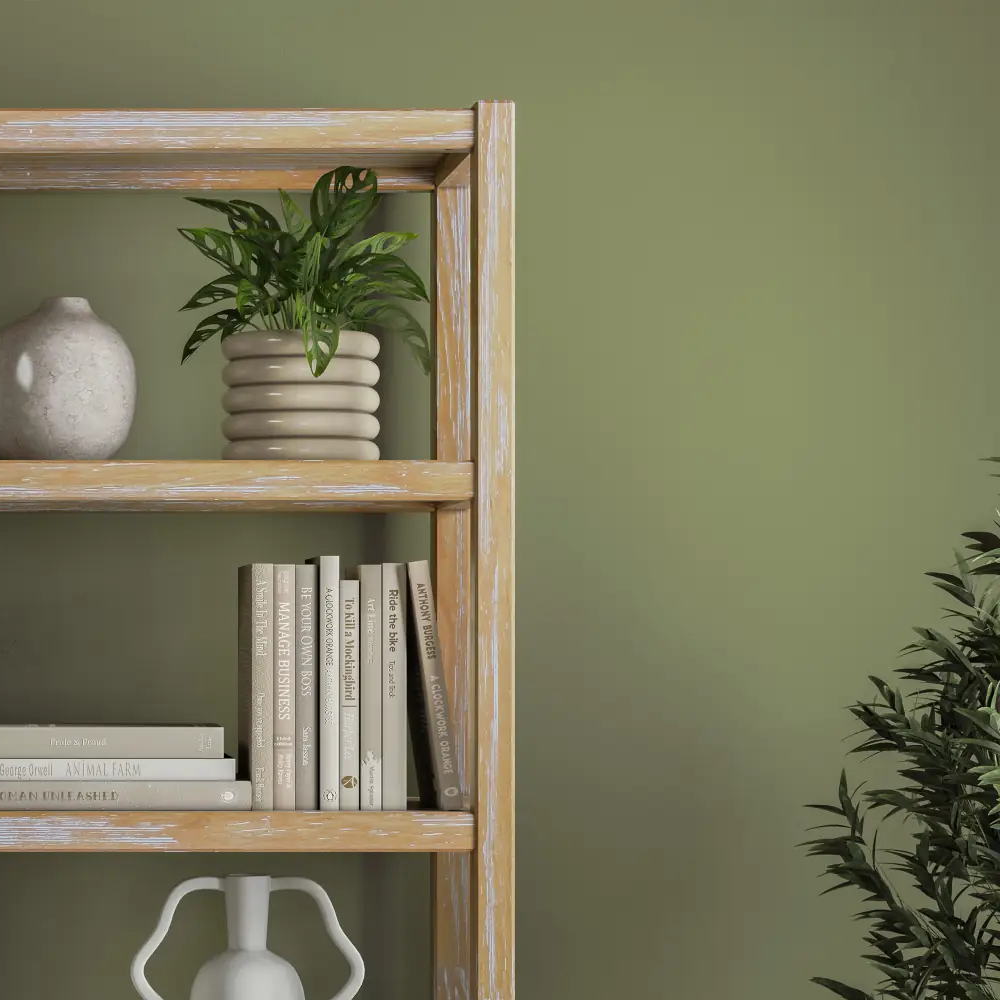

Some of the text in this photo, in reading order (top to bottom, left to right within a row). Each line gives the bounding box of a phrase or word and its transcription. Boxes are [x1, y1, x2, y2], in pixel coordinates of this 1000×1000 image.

[345, 598, 355, 610] To
[367, 598, 376, 611] Art
[256, 620, 268, 634] The
[279, 602, 290, 656] MANAGE
[345, 612, 356, 630] Kill
[389, 590, 399, 652] Ride the bike
[416, 583, 437, 660] ANTHONY BURGESS
[256, 636, 268, 656] Mind
[301, 588, 313, 696] BE YOUR OWN BOSS
[342, 639, 356, 700] Mockingbird
[388, 660, 396, 672] Tips
[388, 673, 396, 684] and
[279, 660, 290, 720] BUSINESS
[430, 675, 454, 774] A CLOCKWORK ORANGE
[50, 738, 71, 746] Pride
[82, 738, 107, 746] Proud
[302, 726, 312, 742] Sara
[0, 762, 53, 778] George Orwell
[65, 760, 142, 777] ANIMAL FARM
[43, 790, 118, 801] UNLEASHED
